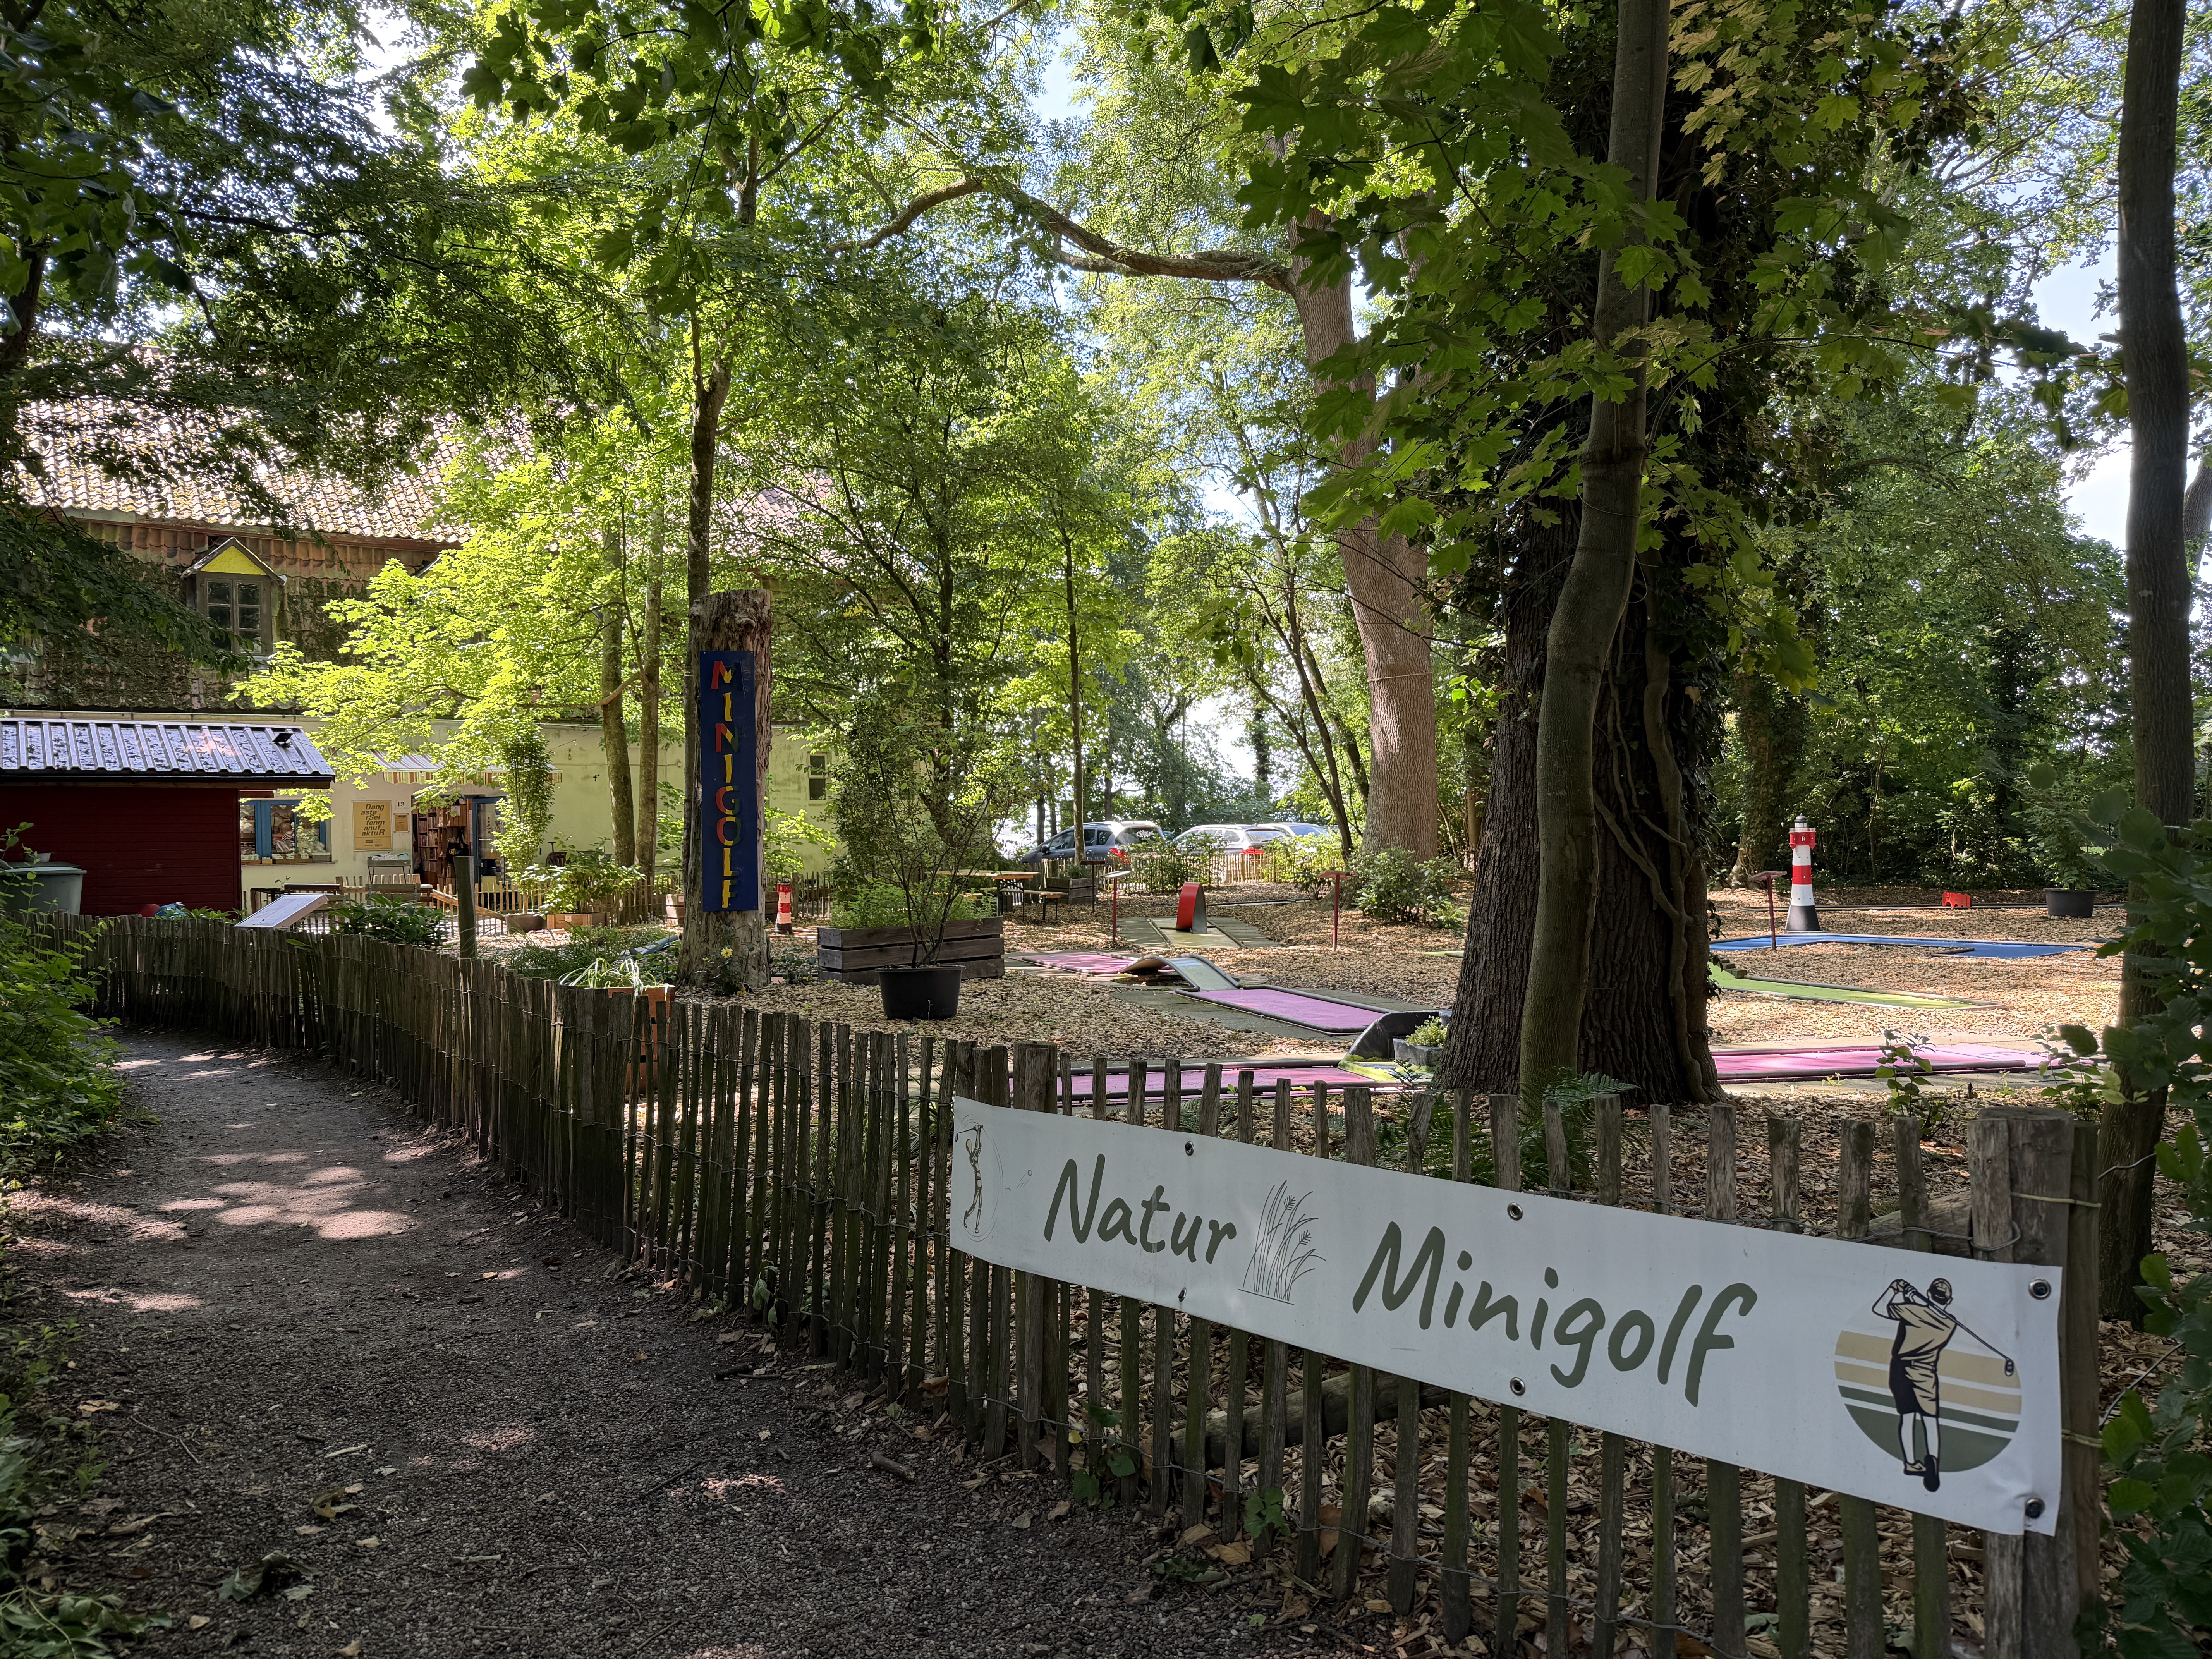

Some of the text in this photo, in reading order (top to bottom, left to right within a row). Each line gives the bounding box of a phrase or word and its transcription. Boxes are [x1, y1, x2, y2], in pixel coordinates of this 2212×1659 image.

[711, 660, 744, 908] MINIGOLF
[1044, 1153, 1758, 1408] Natur Minigolf
